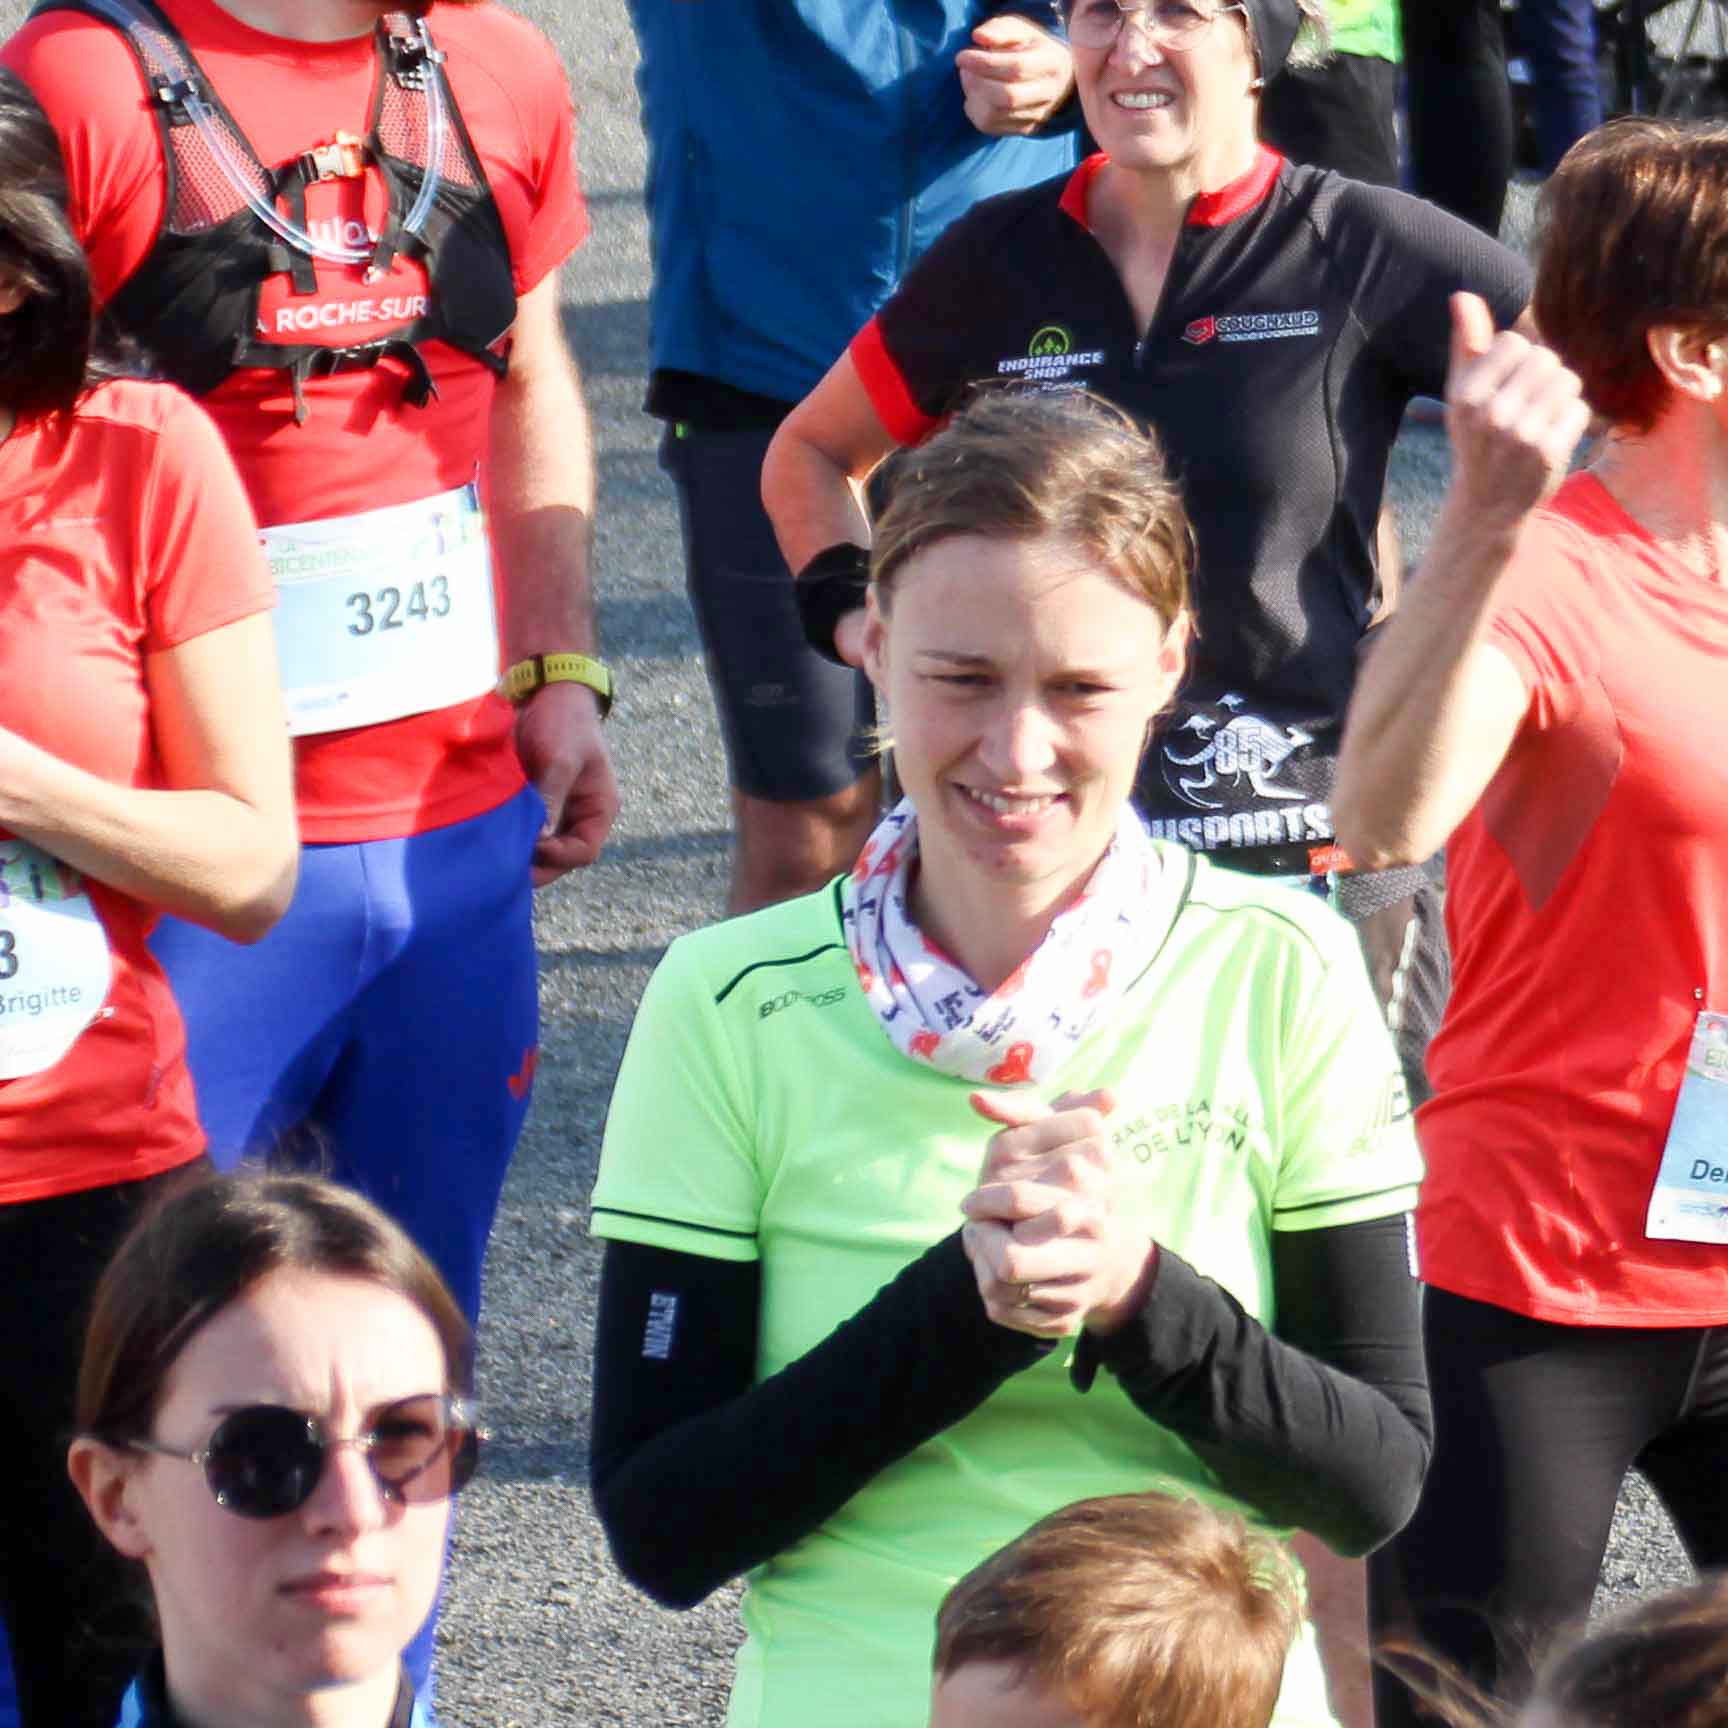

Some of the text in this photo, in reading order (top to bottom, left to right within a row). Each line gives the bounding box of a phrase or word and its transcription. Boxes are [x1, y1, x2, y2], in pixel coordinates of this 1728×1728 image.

[998, 351, 1104, 374] ENDURANCE
[1023, 366, 1068, 381] SHOP
[346, 574, 452, 637] 3243
[1214, 726, 1262, 775] 85
[759, 986, 847, 1019] BODOSS
